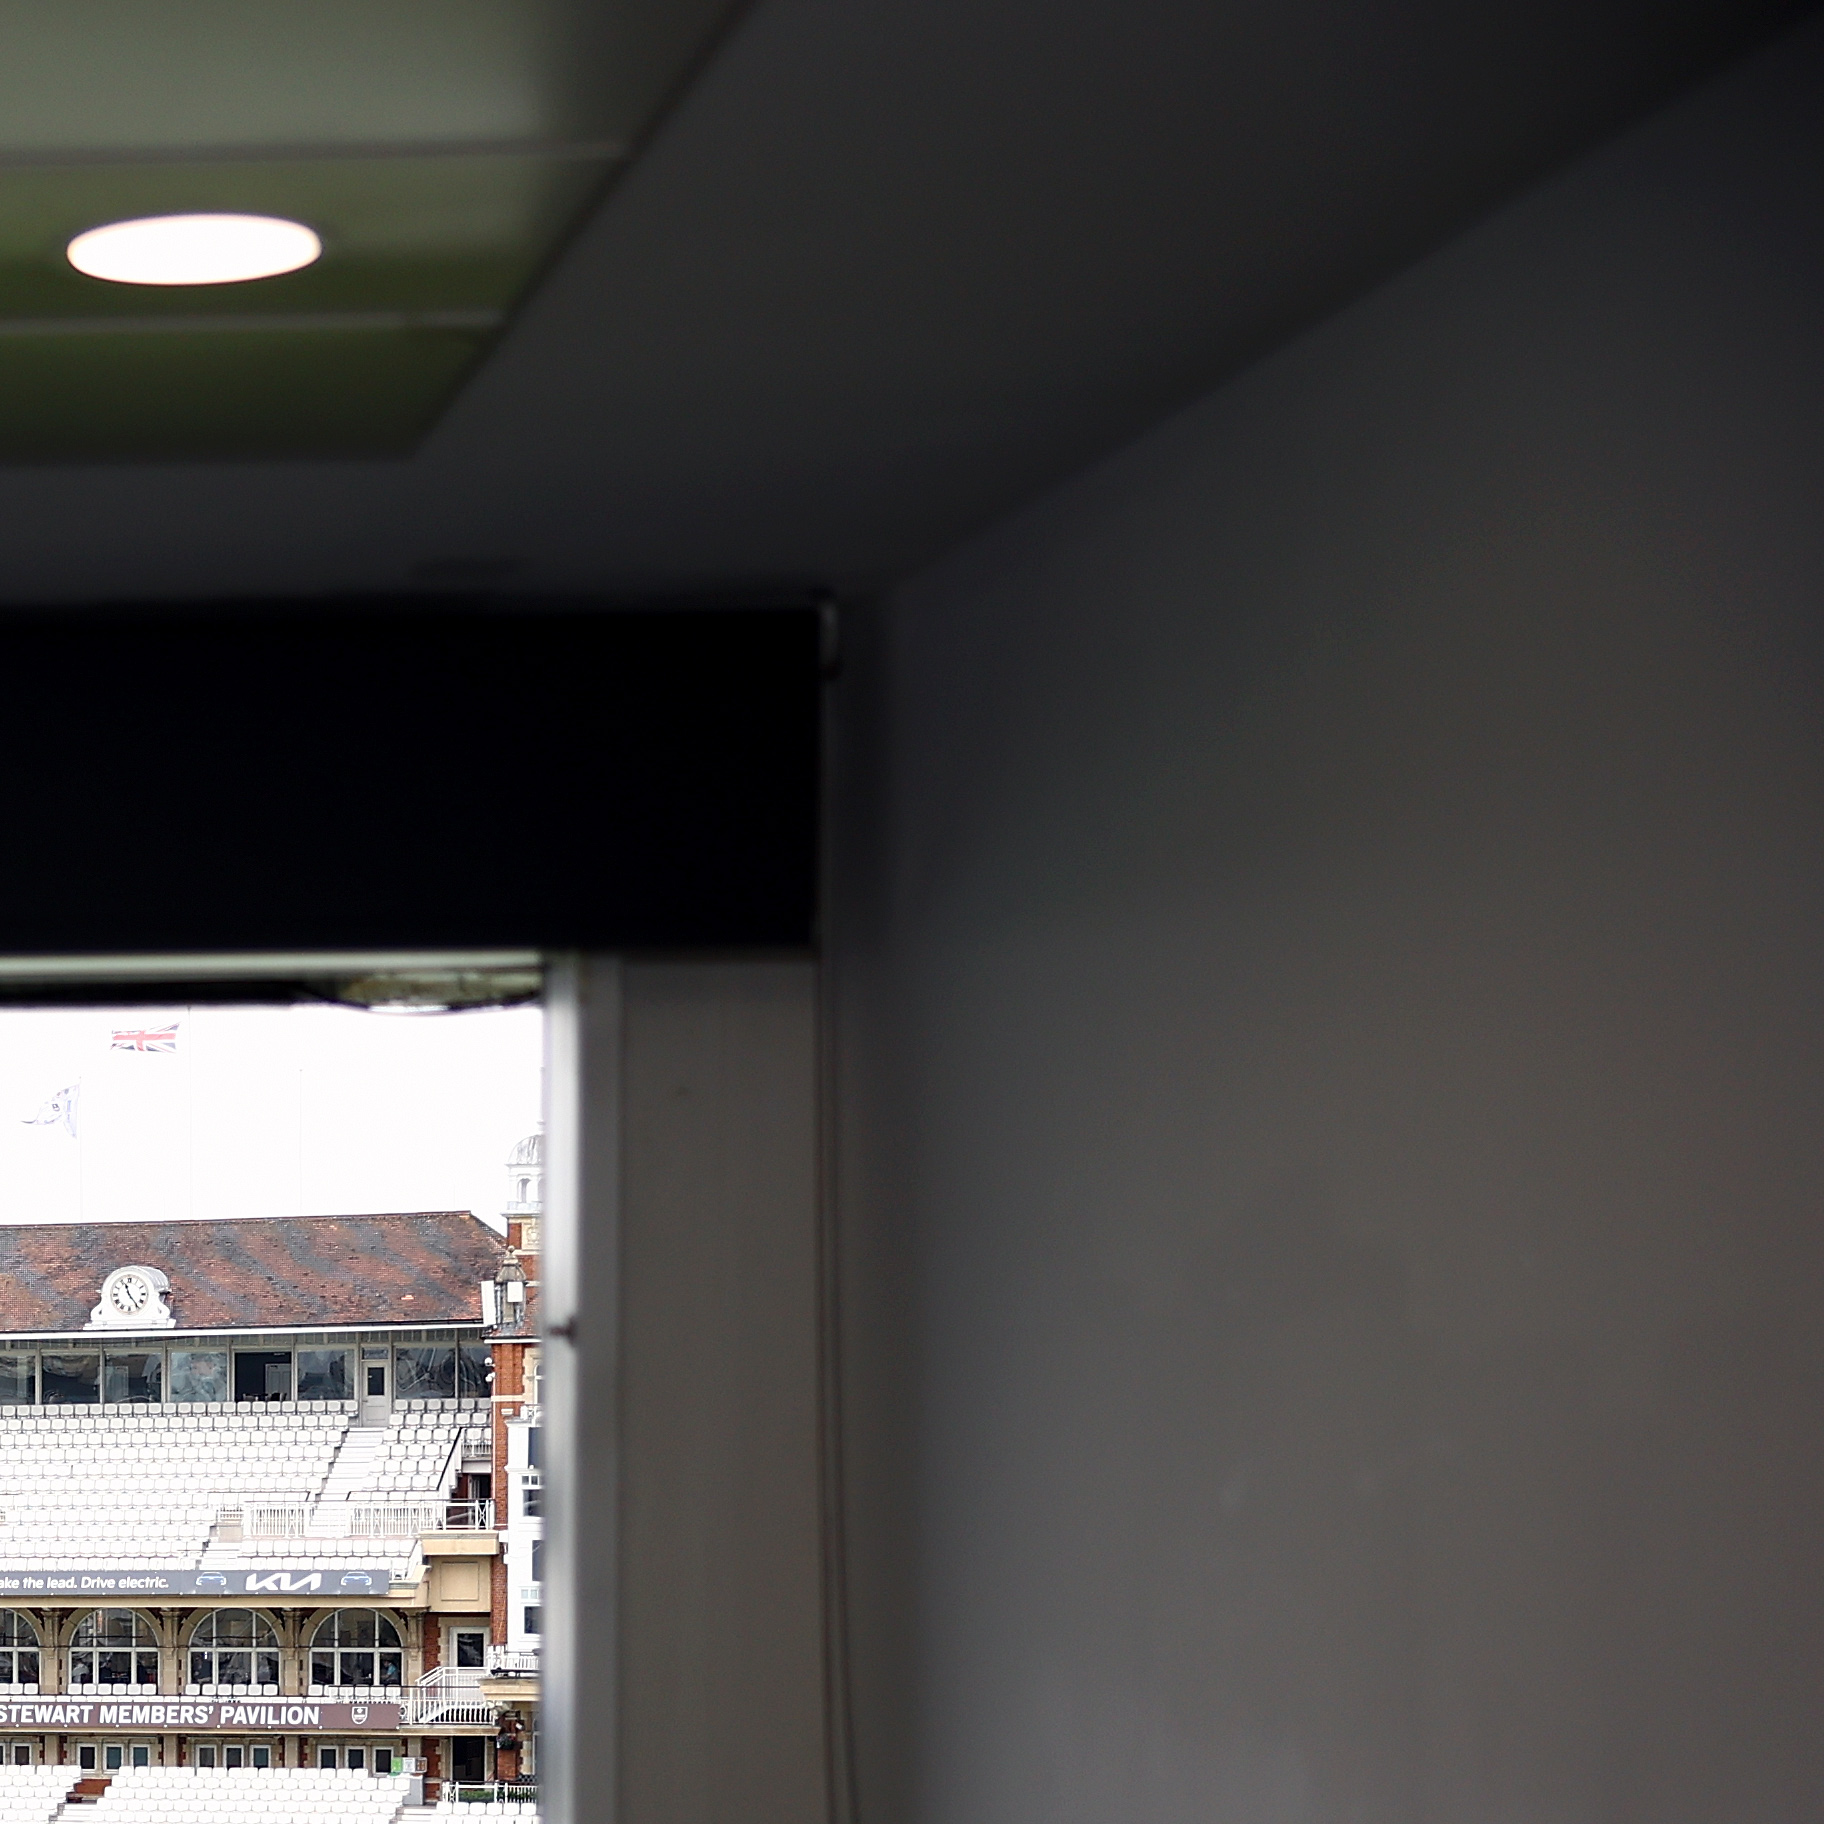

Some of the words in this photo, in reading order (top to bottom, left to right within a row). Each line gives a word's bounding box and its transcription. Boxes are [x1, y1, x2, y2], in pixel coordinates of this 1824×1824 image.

[22, 1576, 44, 1589] the
[47, 1576, 78, 1589] lead.
[81, 1576, 116, 1589] Drive
[118, 1576, 169, 1589] electric.
[220, 1705, 320, 1725] PAVILION
